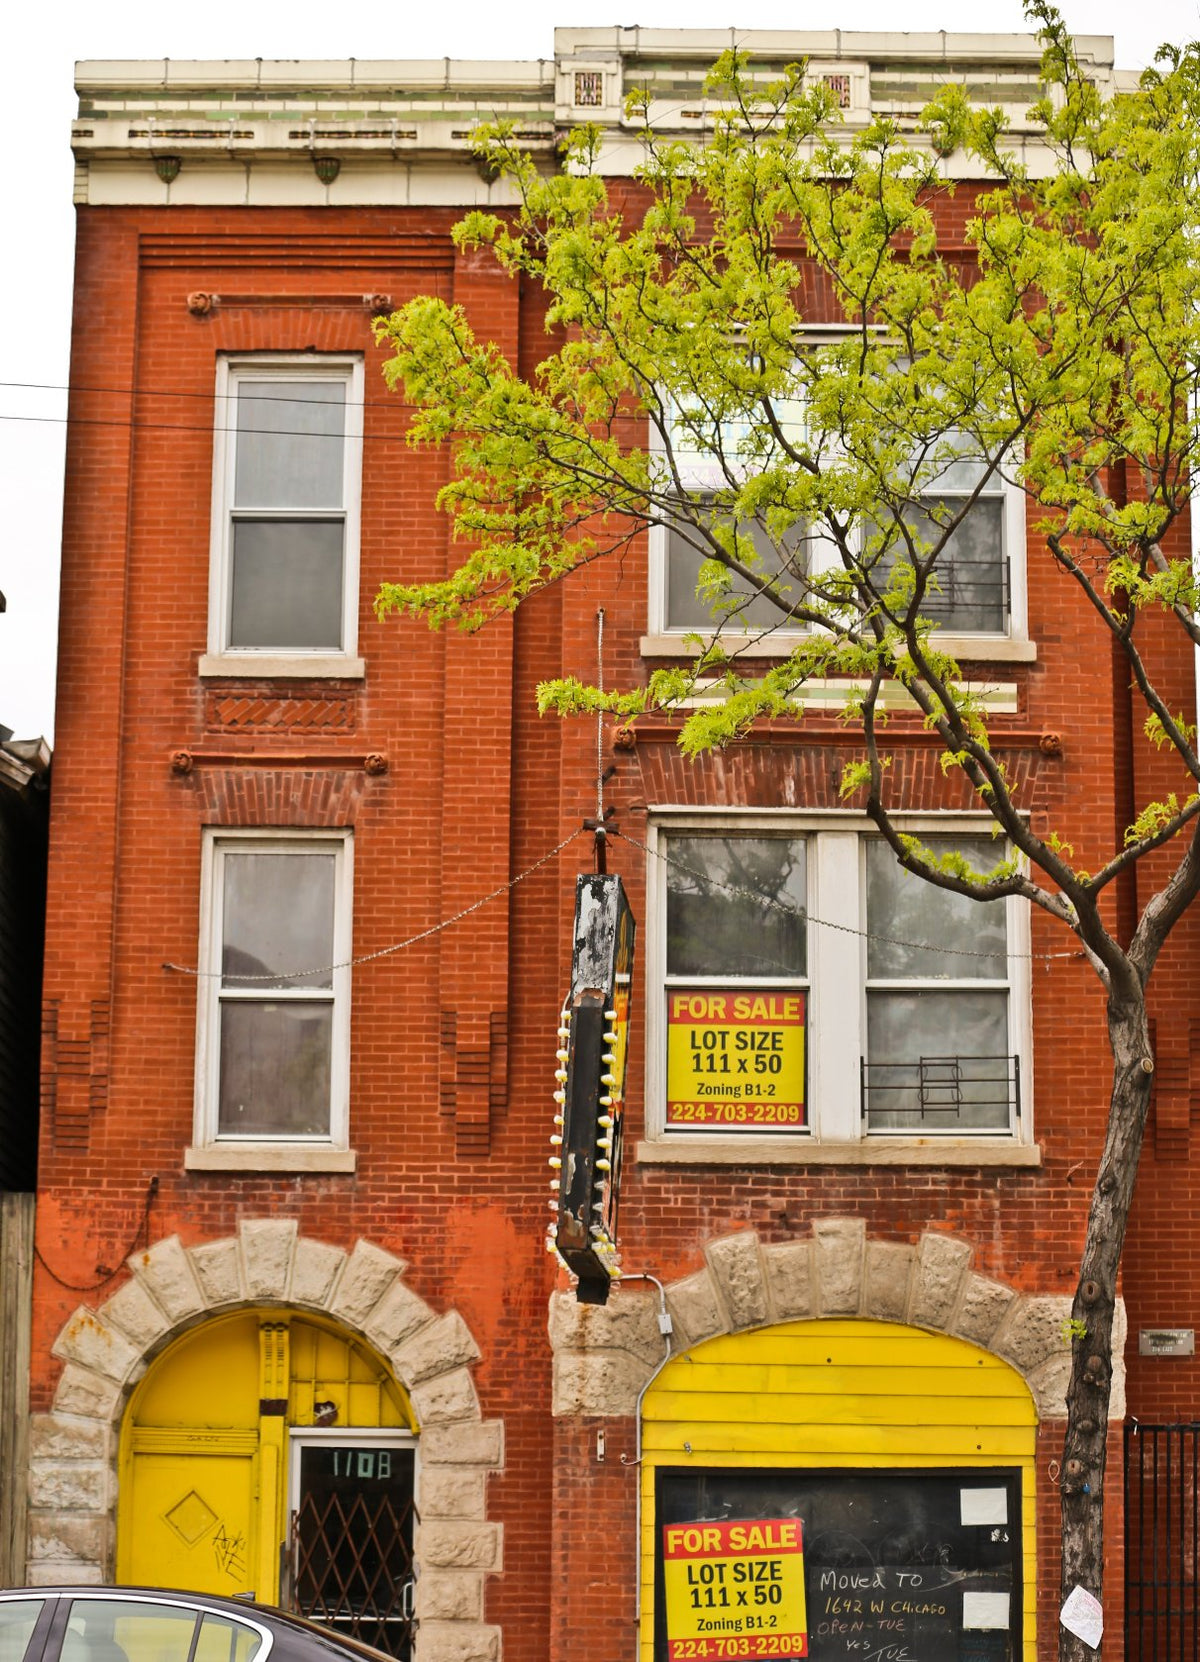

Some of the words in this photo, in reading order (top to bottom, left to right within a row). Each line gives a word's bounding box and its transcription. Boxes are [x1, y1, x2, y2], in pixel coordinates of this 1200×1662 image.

[673, 995, 727, 1019] FOR
[733, 996, 801, 1021] SALE
[690, 1030, 730, 1050] LOT
[735, 1031, 784, 1051] SIZE
[692, 1053, 731, 1073] 111
[753, 1054, 782, 1074] 50
[696, 1082, 741, 1098] Zoning
[744, 1083, 776, 1096] B1-2
[672, 1103, 800, 1122] 224-703-2209
[667, 1528, 722, 1554] FOR
[729, 1523, 798, 1551] SALE
[687, 1563, 727, 1585] LOT
[733, 1560, 783, 1583] SIZE
[691, 1586, 731, 1609] 111
[753, 1584, 782, 1605] 50
[825, 1597, 863, 1614] 1642
[870, 1600, 884, 1614] W
[697, 1617, 742, 1632] Zoning
[746, 1615, 778, 1629] B1-2
[673, 1635, 803, 1659] 224-703-2209
